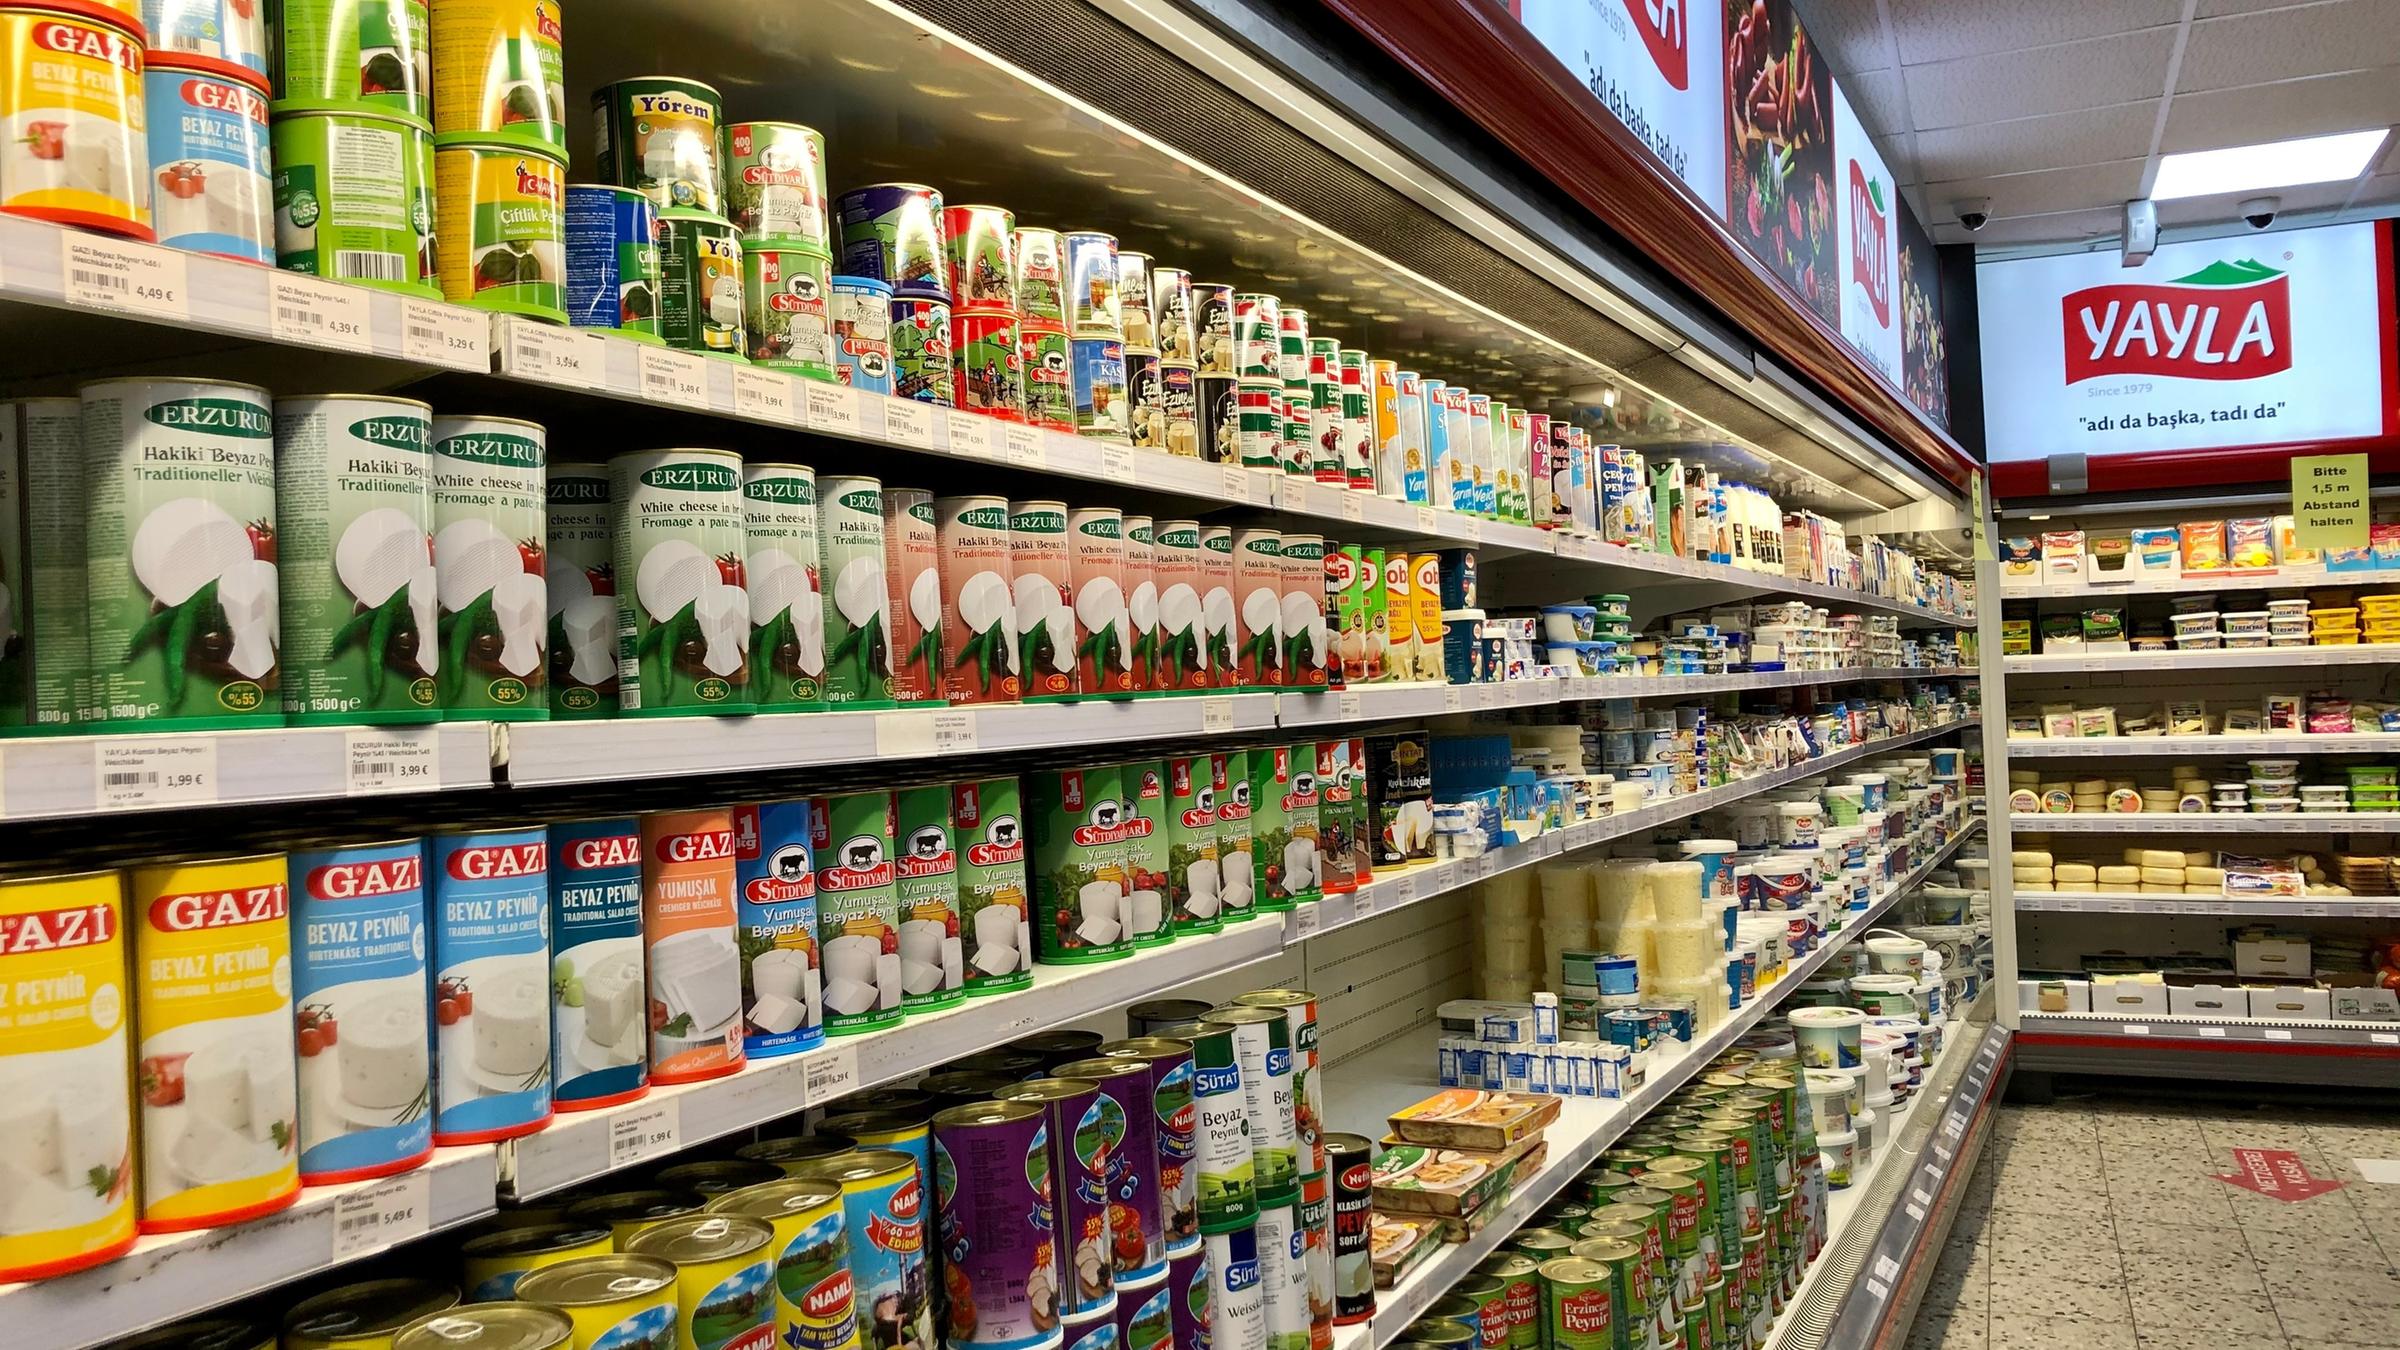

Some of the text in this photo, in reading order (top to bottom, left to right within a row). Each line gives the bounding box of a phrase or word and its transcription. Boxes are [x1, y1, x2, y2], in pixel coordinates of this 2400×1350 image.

[640, 97, 708, 120] Yörem
[182, 117, 221, 136] BEYAZ
[1609, 79, 1622, 120] da
[1656, 130, 1672, 169] tadı
[735, 136, 749, 146] 400
[501, 208, 538, 227] Çiftlik
[1853, 184, 1887, 305] YAYLA
[72, 255, 112, 268] Weichkäse
[137, 286, 174, 301] 4,49 €
[409, 305, 426, 313] YAYLA
[330, 321, 359, 335] 4,39 €
[2080, 300, 2275, 364] YAYLA
[449, 337, 474, 350] 3,29 €
[680, 382, 700, 394] 3,49 €
[2088, 383, 2153, 398] Since 1979
[765, 396, 783, 407] 3,99 €
[2079, 402, 2285, 432] "adı da başka, tadı da"
[144, 447, 256, 465] Hakiki Beyaz
[349, 460, 399, 474] Hakiki
[2313, 466, 2347, 477] Bitte
[134, 467, 243, 483] Traditioneller
[434, 474, 534, 490] White cheese in
[338, 478, 424, 495] Traditioneller
[2312, 483, 2349, 494] 1,5 m
[435, 492, 534, 508] Fromage pate
[2303, 499, 2360, 510] Abstand
[640, 502, 730, 514] White cheese in
[551, 513, 590, 525] cheese
[641, 517, 729, 529] Fromage pate
[776, 513, 806, 524] cheese
[2310, 517, 2353, 527] halten
[840, 522, 871, 533] Hakiki
[958, 537, 989, 547] Hakiki
[1037, 541, 1060, 551] Beyaz
[1080, 545, 1103, 555] White
[1157, 554, 1183, 564] Hakiki
[498, 687, 520, 699] 55%
[703, 686, 724, 697] 55%
[798, 686, 814, 695] 55%
[111, 705, 138, 717] 1500
[310, 698, 338, 711] 1500
[401, 765, 427, 777] 3,99 €
[167, 774, 203, 787] 1,99 €
[959, 810, 976, 820] kg
[1079, 862, 1111, 872] Beyaz
[562, 880, 639, 908] BEYAZ PEYNİR
[659, 878, 717, 900] YUMUŞAK
[902, 879, 952, 897] Yumuşak
[974, 881, 1008, 896] Beyaz
[167, 882, 286, 929] GAZİ
[447, 891, 538, 922] BEYAZ PEYNİR
[834, 891, 890, 910] Yumuşak
[563, 908, 624, 922] TRADITIONAL SALAD
[824, 908, 865, 924] Beyaz
[308, 910, 410, 945] BEYAZ PEYNİR
[448, 921, 518, 937] TRADITIONAL SALAD
[752, 924, 793, 938] Beyaz
[309, 946, 361, 962] HIRTENKÄSE
[151, 944, 270, 981] BEYAZ PEYNİR
[16, 970, 86, 1006] PEYNİR
[984, 977, 1013, 986] HIRTENKÄSE
[902, 995, 935, 1005] HIRTENKÄSE
[833, 1012, 887, 1026] HIRTENKÄSE SOFT
[762, 1036, 796, 1047] HIRTENKÄSE
[1198, 1071, 1239, 1092] SÜTAT
[1202, 1107, 1242, 1127] Beyaz
[651, 1130, 671, 1144] 5,99 €
[1211, 1125, 1240, 1141] Peynir
[1162, 1169, 1181, 1181] 55%
[1226, 1203, 1244, 1213] 800g
[385, 1208, 413, 1224] 5,49 €
[1339, 1236, 1358, 1247] SOFT
[1565, 1301, 1609, 1314] Erzincan
[1566, 1313, 1608, 1331] Peynir
[802, 1329, 816, 1339] TAM
